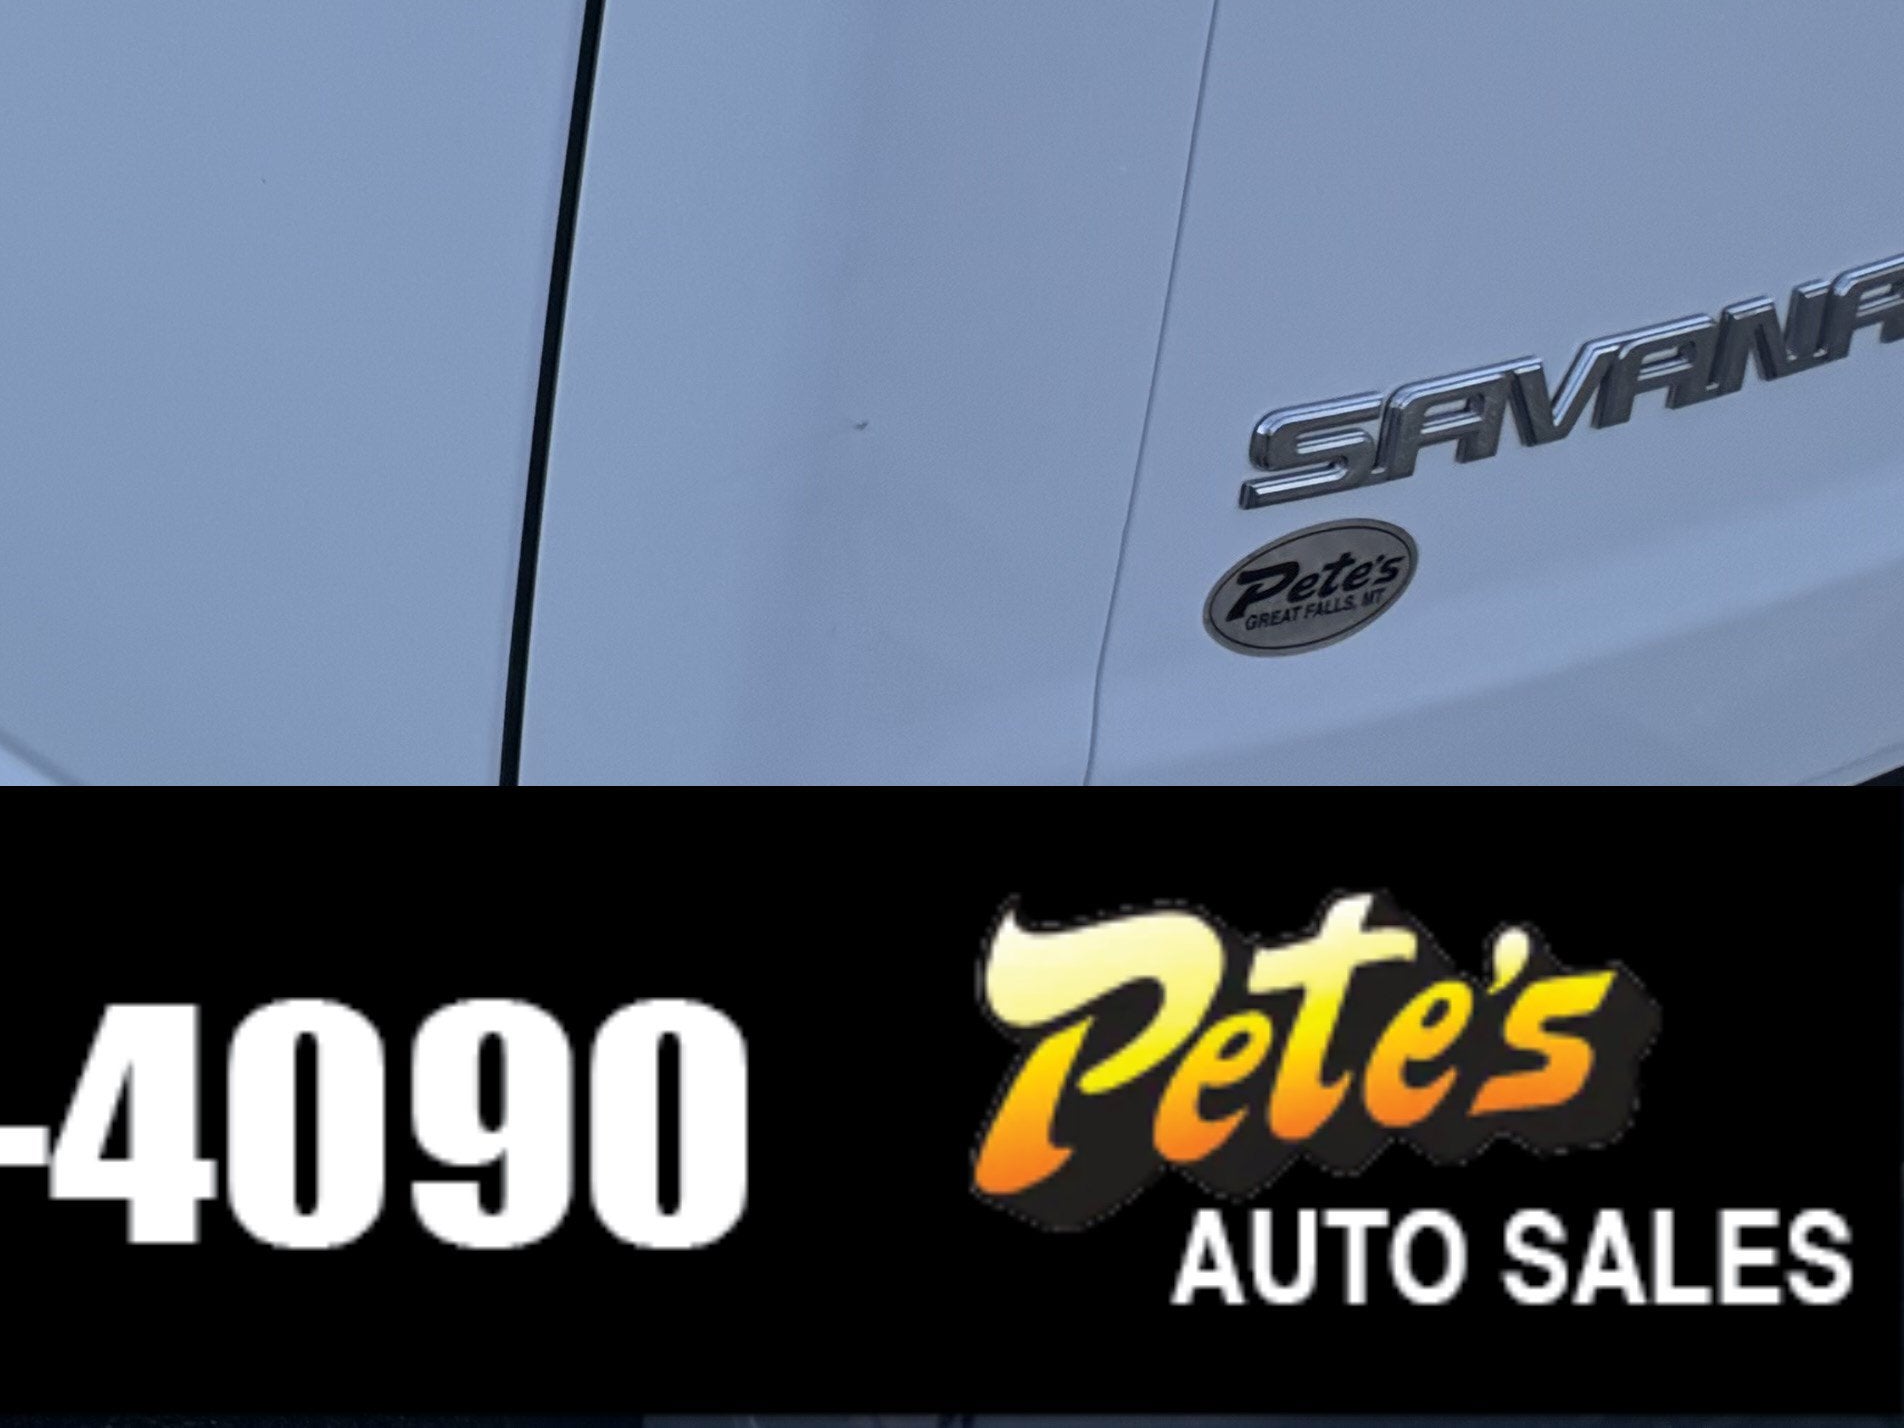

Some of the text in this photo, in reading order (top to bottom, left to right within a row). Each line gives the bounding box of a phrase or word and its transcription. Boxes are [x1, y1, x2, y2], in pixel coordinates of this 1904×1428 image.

[1238, 250, 1904, 510] SAVANA
[1226, 552, 1406, 622] Pete's
[1244, 606, 1302, 631] GREAT
[1362, 587, 1386, 608] MT
